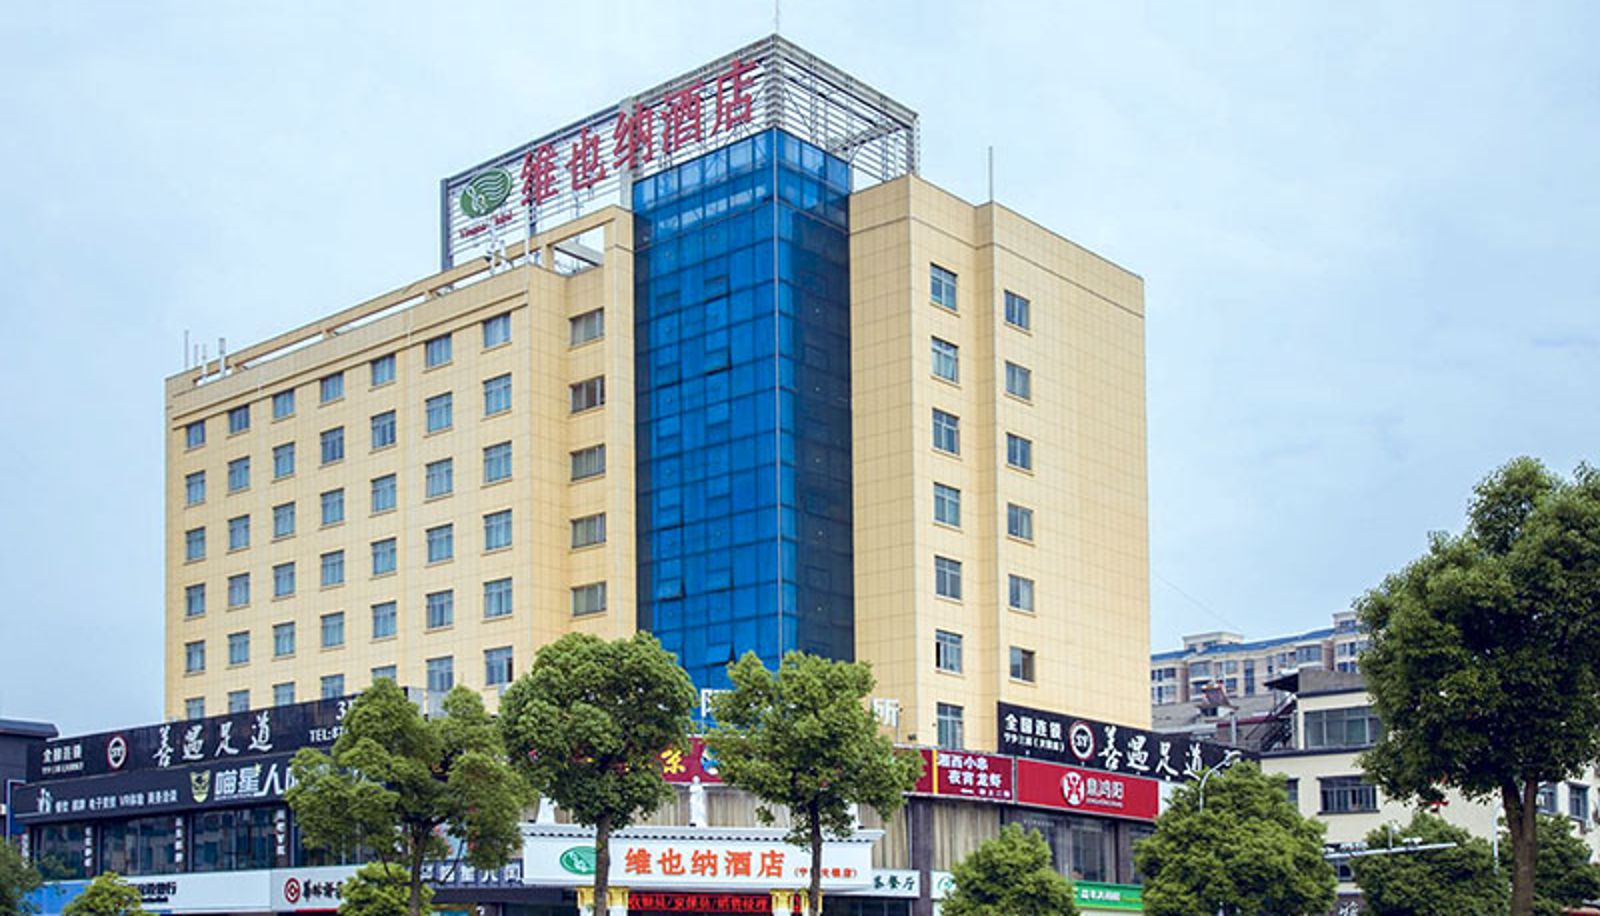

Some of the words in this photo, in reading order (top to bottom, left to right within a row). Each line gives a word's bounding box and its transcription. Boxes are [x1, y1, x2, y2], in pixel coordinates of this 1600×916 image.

[520, 58, 757, 206] 维也纳酒店
[1004, 713, 1062, 740] 全国连锁
[624, 847, 786, 878] 维也纳酒店
